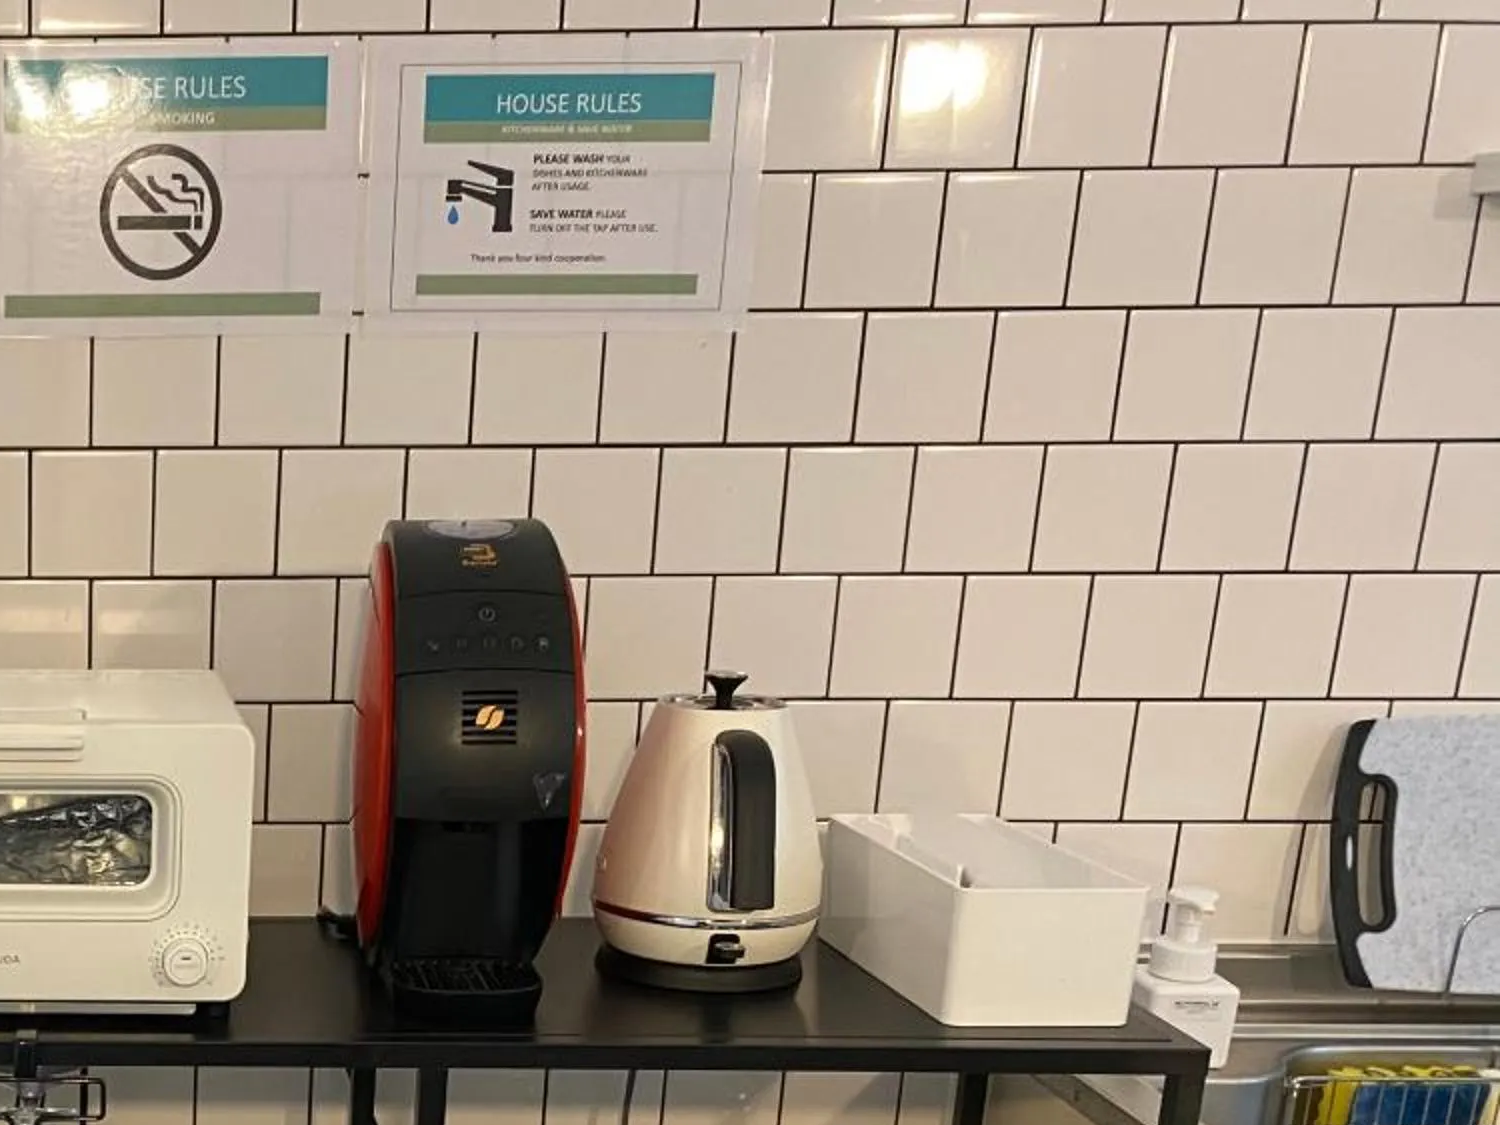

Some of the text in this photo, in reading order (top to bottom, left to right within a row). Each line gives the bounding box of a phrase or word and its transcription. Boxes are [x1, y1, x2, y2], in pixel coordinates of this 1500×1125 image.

[174, 75, 247, 99] RULES
[495, 92, 642, 114] HOUSE RULES
[533, 153, 631, 164] PLEASE WASH YOUR
[532, 168, 648, 178] DISHES AND KITCHENWARE
[531, 181, 559, 191] AFTER
[529, 209, 627, 219] SAVE WATER PLEASE
[529, 223, 553, 233] TURN
[555, 223, 571, 233] OFF
[574, 223, 590, 233] THE
[593, 223, 609, 233] TAP
[609, 223, 636, 233] AFTER
[470, 253, 495, 262] Thank
[498, 255, 513, 263] you
